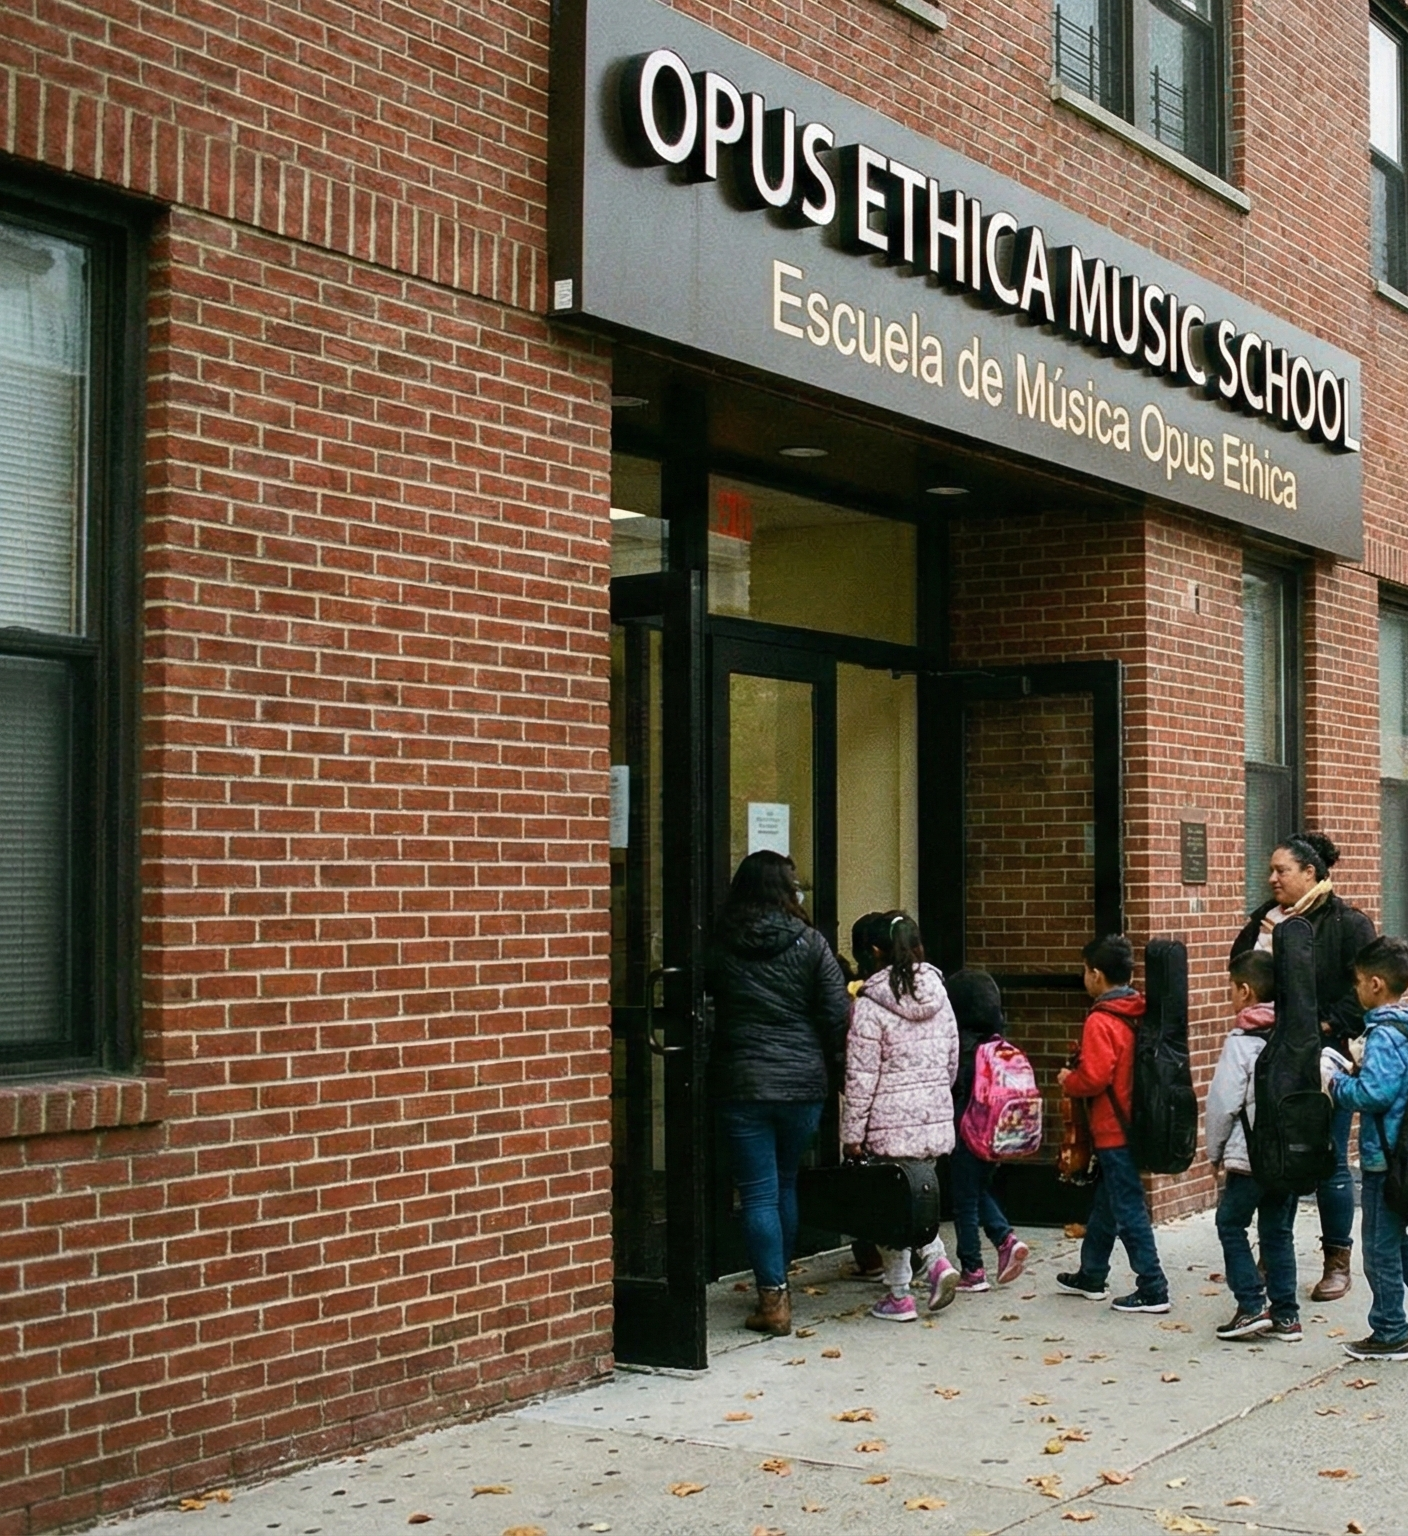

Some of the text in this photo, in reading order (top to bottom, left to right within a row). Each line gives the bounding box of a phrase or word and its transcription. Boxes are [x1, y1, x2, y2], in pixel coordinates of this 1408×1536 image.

[640, 49, 1361, 451] OPUS ETHICA MUSIC SCHOOL
[773, 259, 1297, 510] Escuela de Música Opus Ethica
